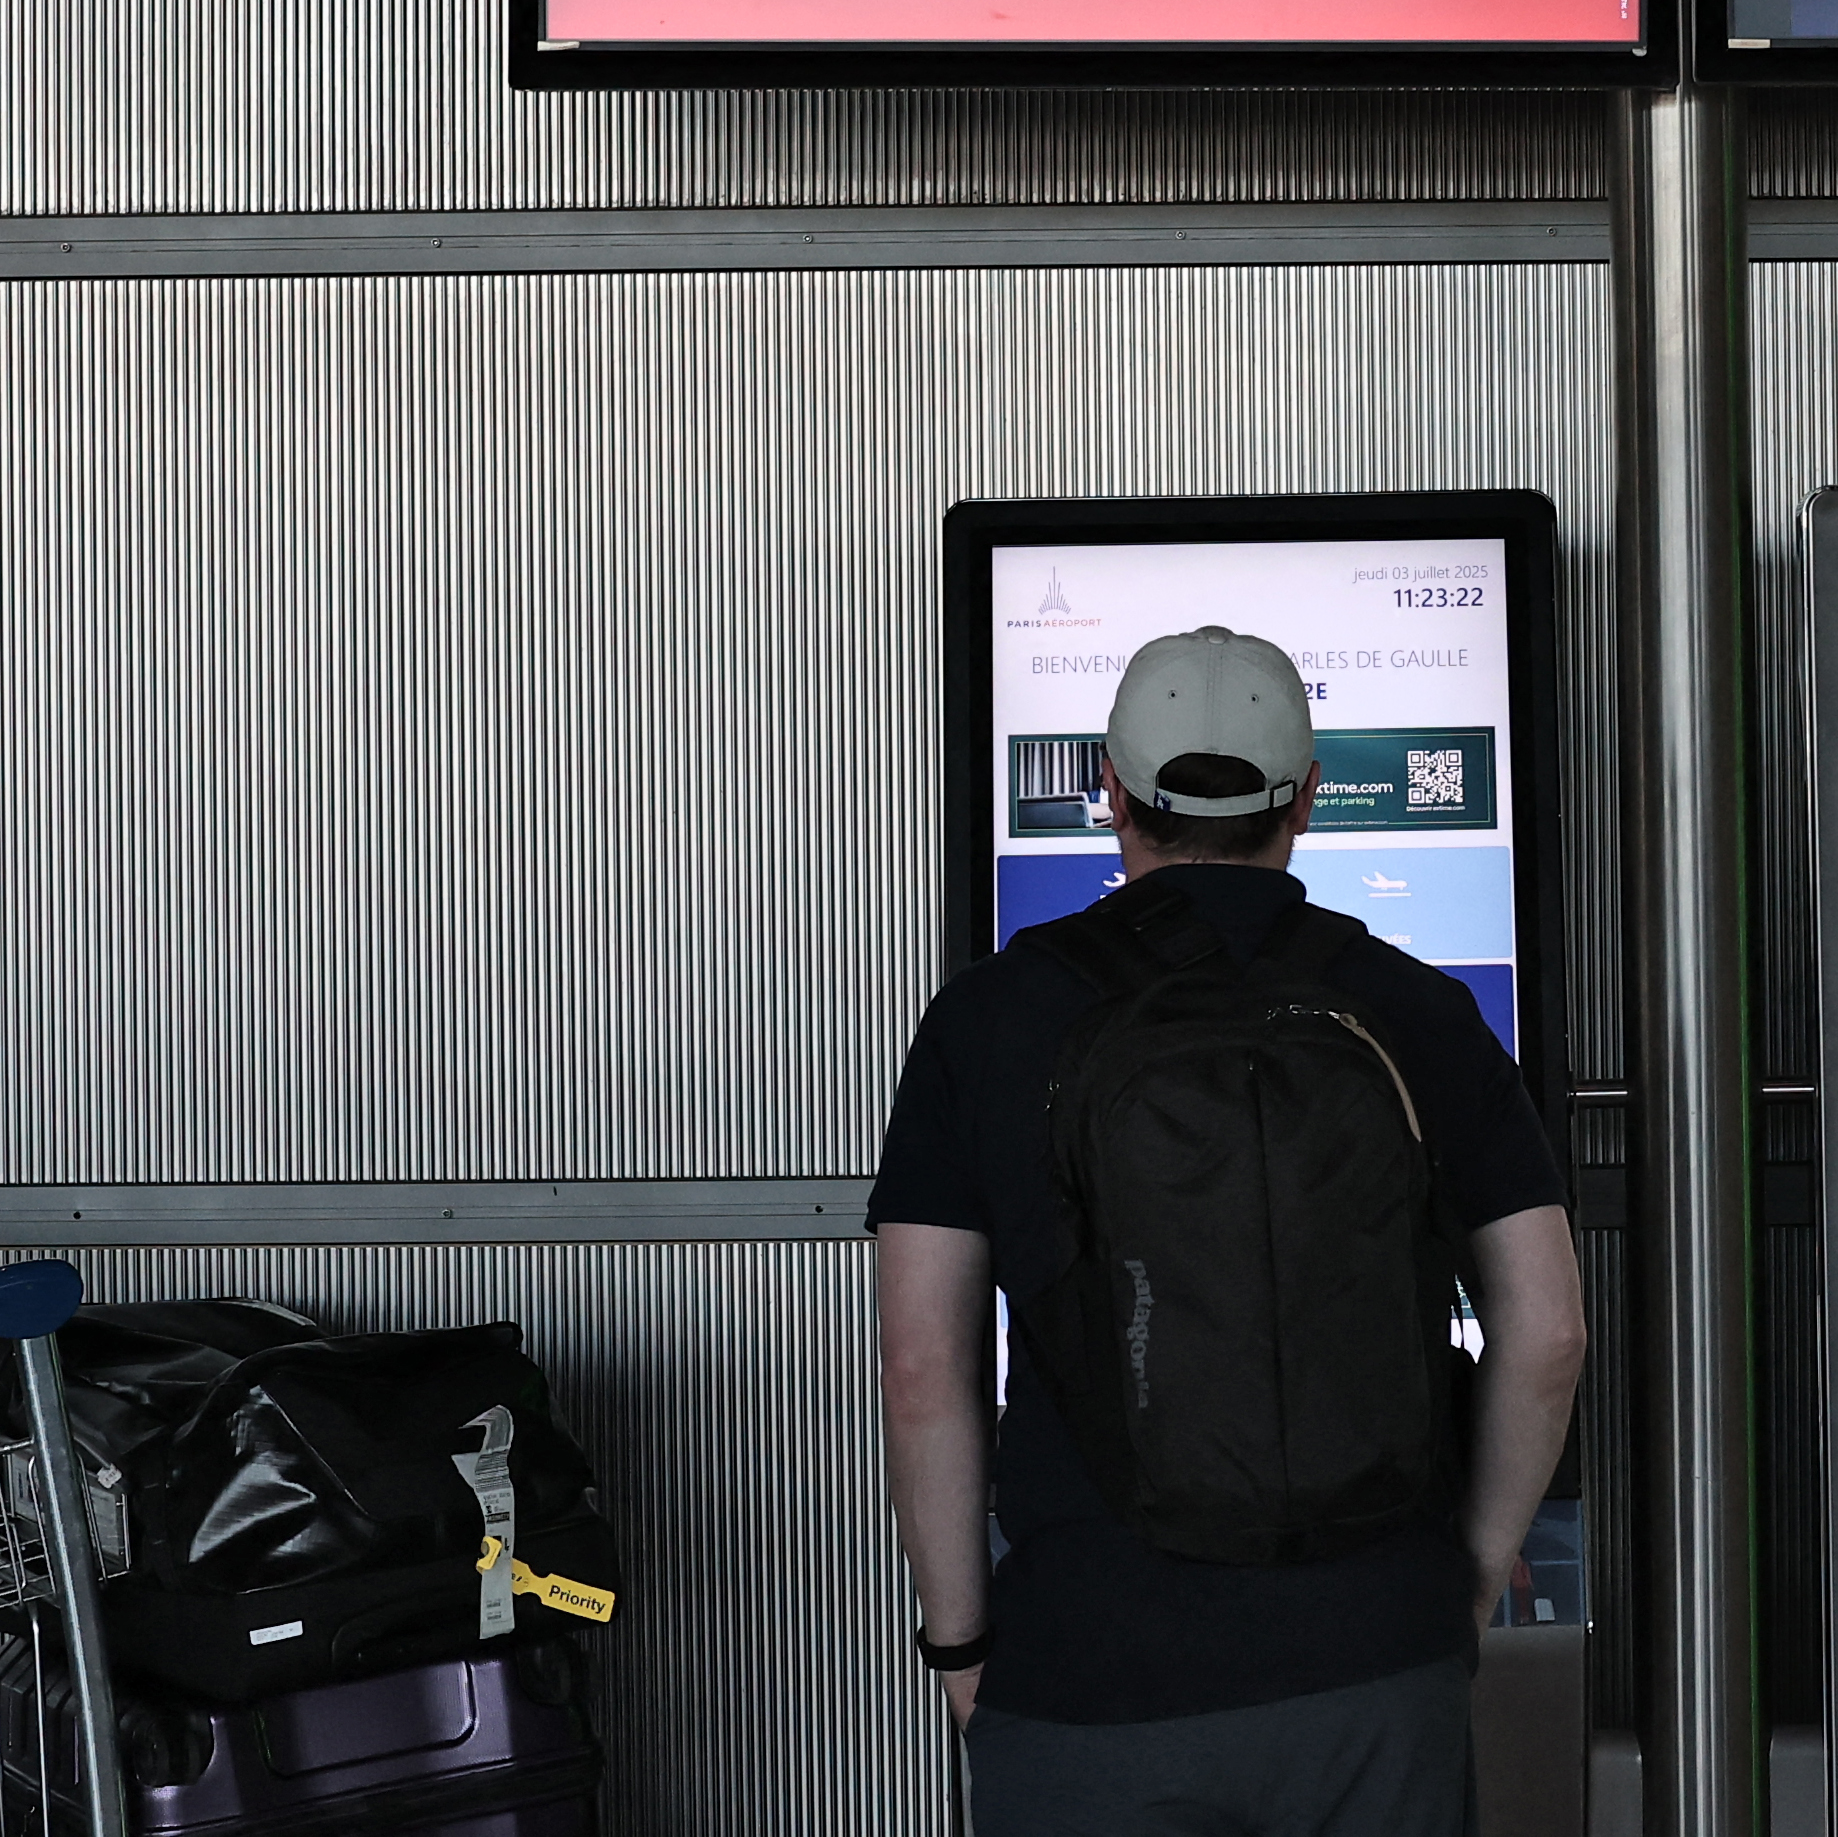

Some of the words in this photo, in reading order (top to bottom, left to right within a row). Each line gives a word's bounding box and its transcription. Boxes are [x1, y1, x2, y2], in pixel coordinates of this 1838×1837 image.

[1352, 566, 1388, 583] jeudi
[1392, 566, 1409, 580] 03
[1412, 565, 1450, 582] juillet
[1454, 565, 1488, 579] 2025
[1393, 587, 1484, 608] 11:23:22
[1355, 651, 1383, 668] DE
[1390, 649, 1469, 668] GAULLE
[1123, 1258, 1154, 1409] patagonia
[548, 1584, 607, 1615] Priority
